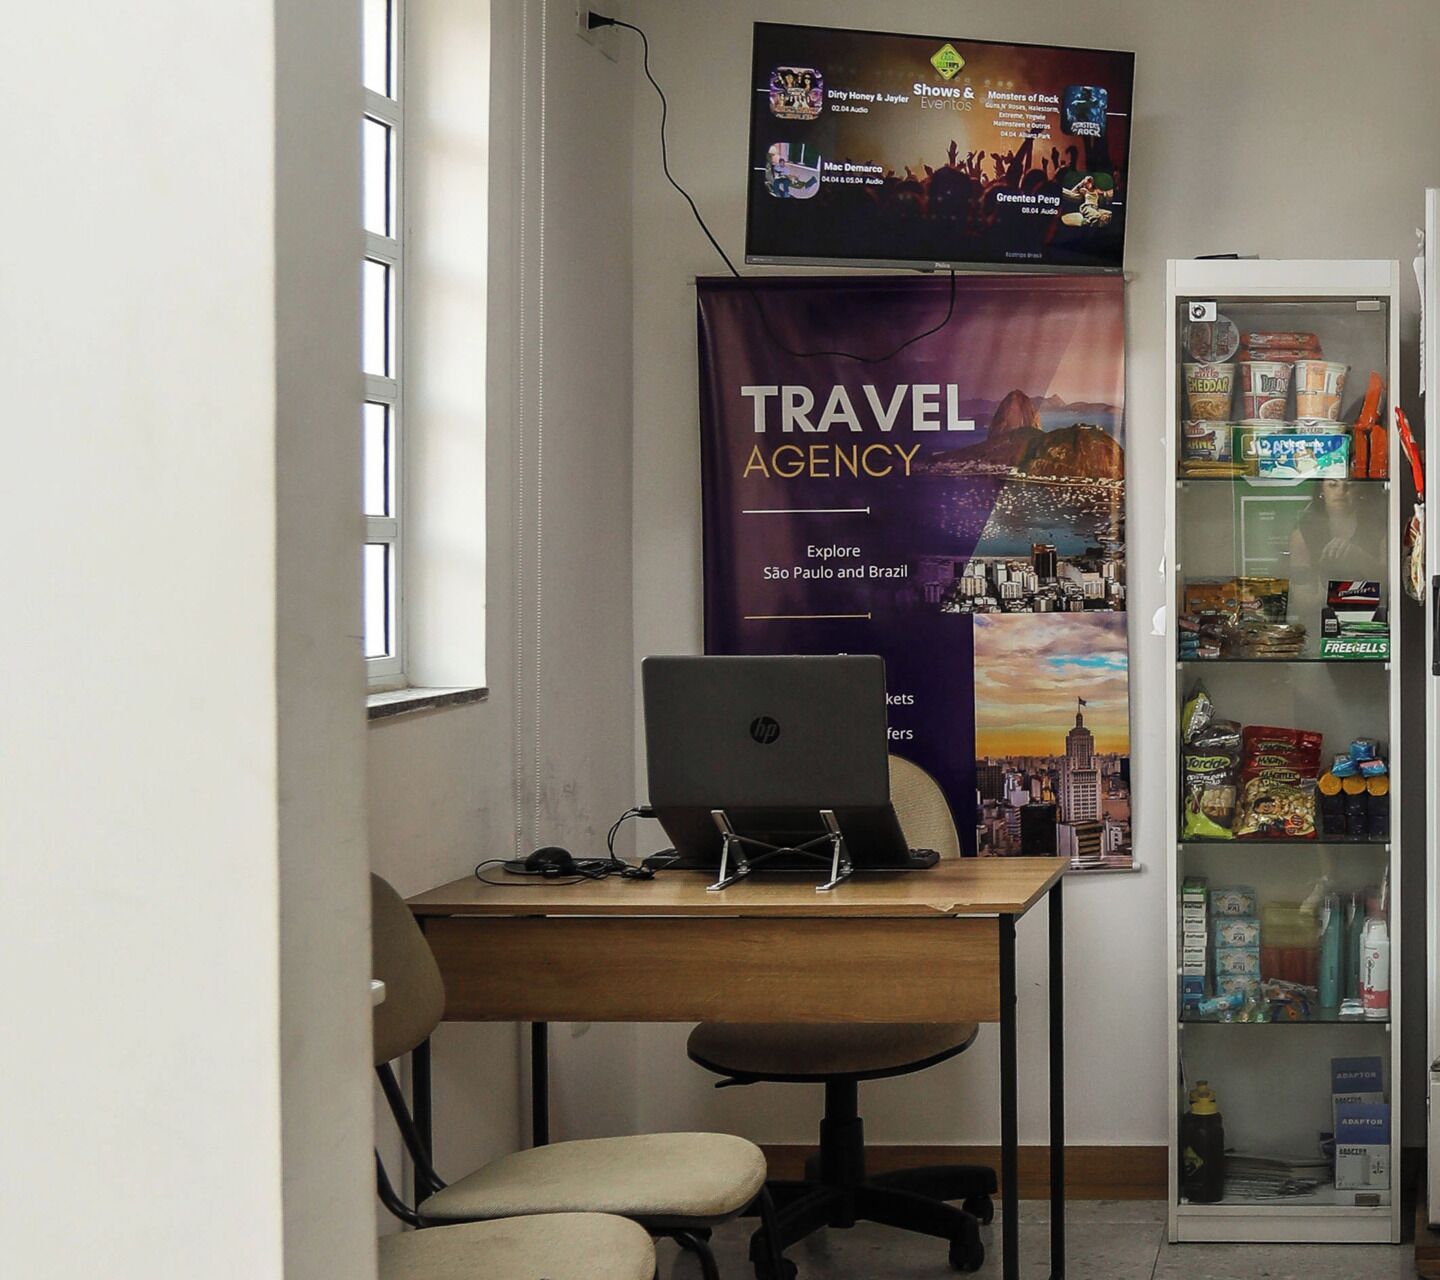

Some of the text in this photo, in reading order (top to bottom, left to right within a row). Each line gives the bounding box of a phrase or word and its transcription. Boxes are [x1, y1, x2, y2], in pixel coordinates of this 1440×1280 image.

[828, 90, 848, 101] Dirty
[849, 91, 875, 102] Honey
[876, 93, 883, 101] &
[913, 83, 975, 99] Shows &
[988, 91, 1060, 104] Monsters of Rock
[850, 105, 869, 114] Audio
[921, 96, 972, 111] Eventos
[824, 162, 883, 173] Mac Demarco
[997, 193, 1060, 207] Greentea Peng
[1040, 207, 1059, 215] Audio
[741, 384, 976, 433] TRAVEL
[743, 444, 921, 478] AGENCY
[807, 545, 861, 560] Explore
[763, 564, 908, 580] São Paulo and Brazil
[1324, 643, 1387, 653] FREEGELLS
[886, 692, 914, 705] kets
[753, 717, 779, 744] hp
[887, 726, 913, 740] fers
[1336, 1071, 1377, 1079] ADAPTOR
[1341, 1118, 1383, 1126] ADAPTOR
